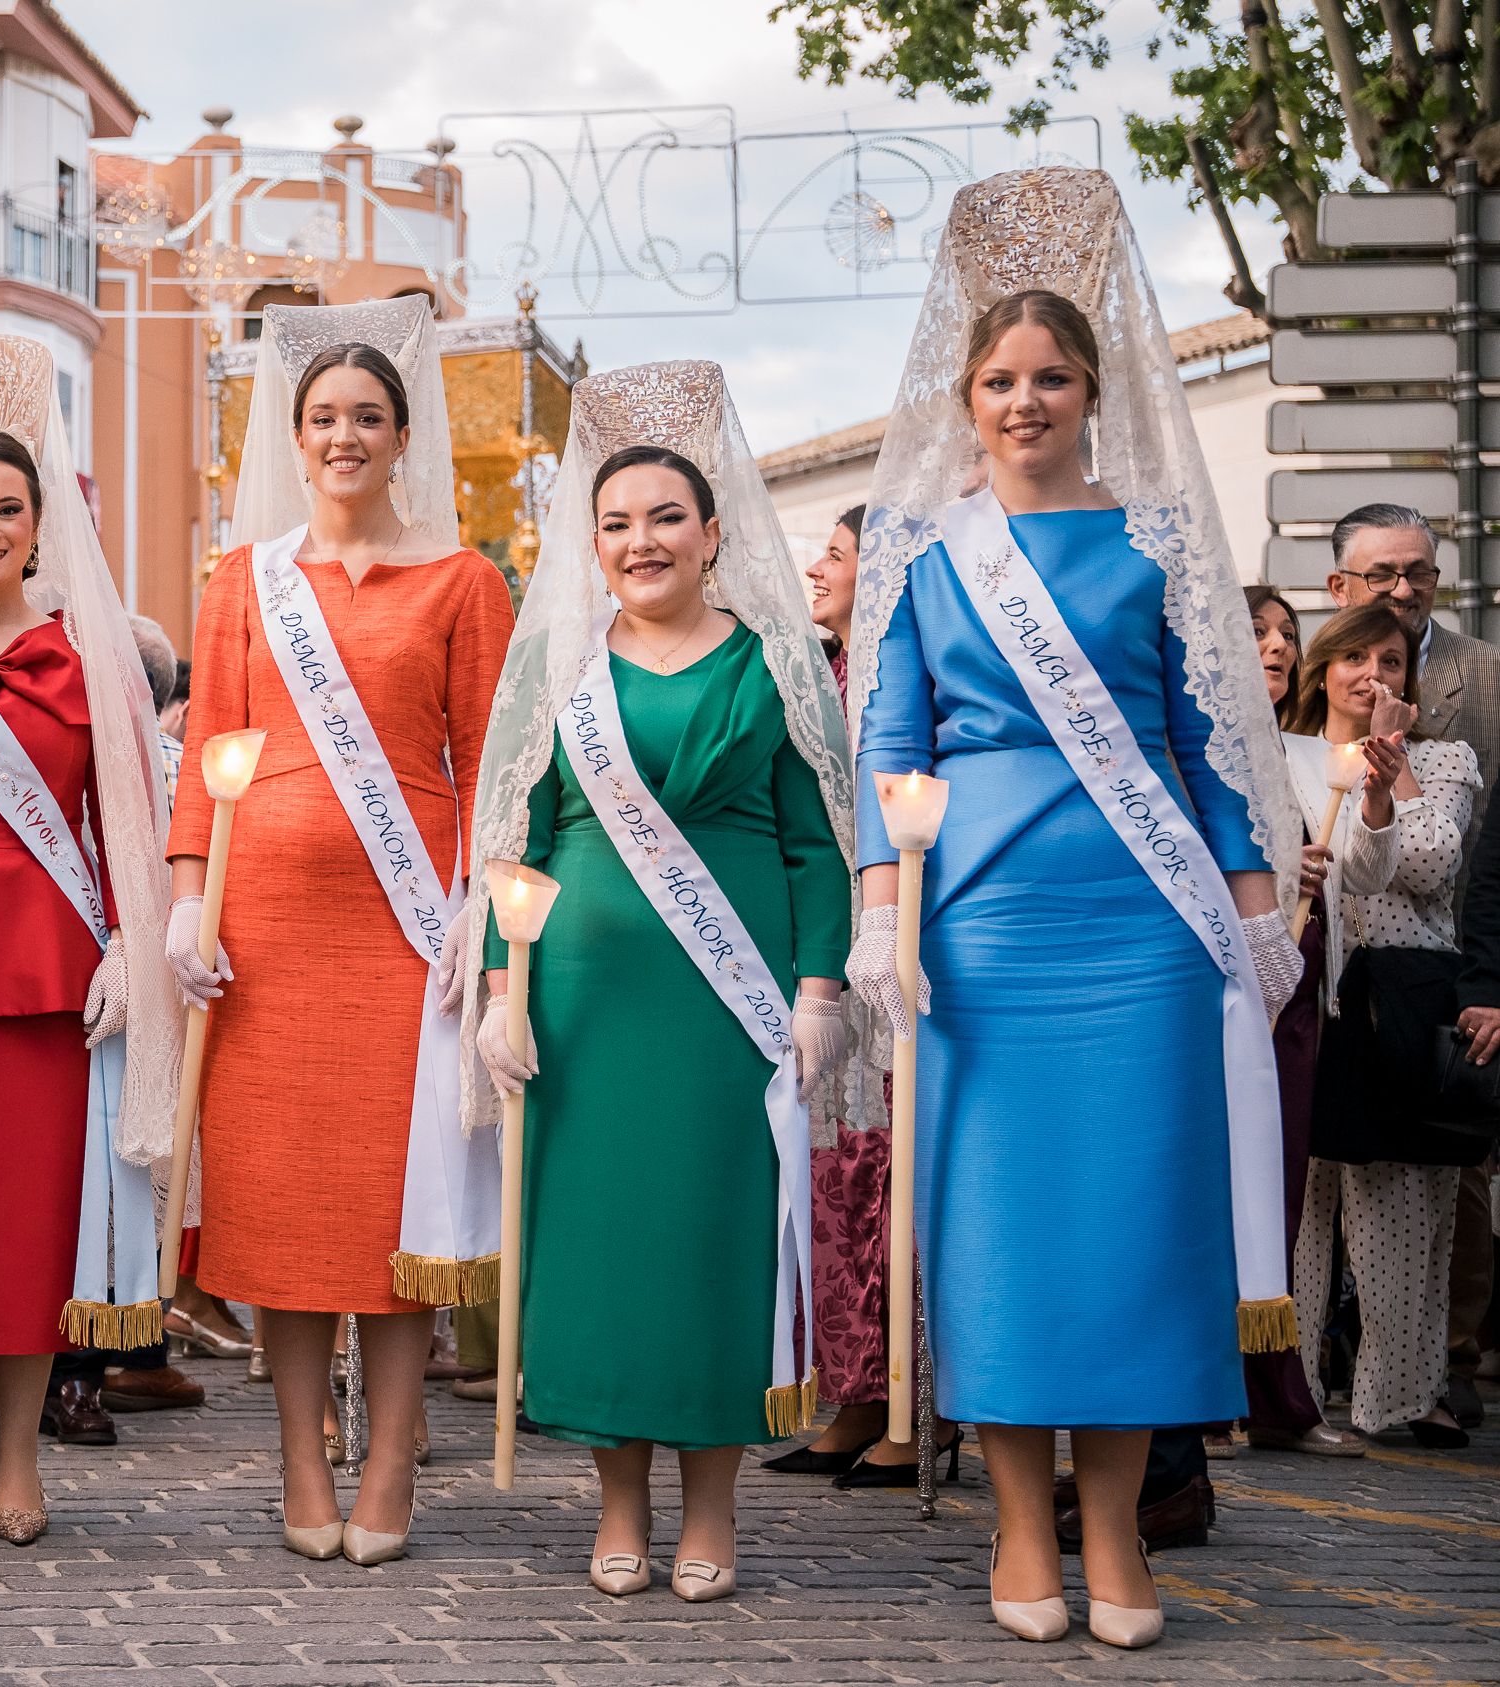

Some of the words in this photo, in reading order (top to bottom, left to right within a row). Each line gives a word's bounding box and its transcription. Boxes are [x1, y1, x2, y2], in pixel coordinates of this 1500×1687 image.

[15, 787, 59, 856] MAYOR
[280, 611, 329, 693] DAMA
[323, 714, 359, 756] DE
[355, 778, 412, 882] HONOR
[570, 692, 613, 777] DAMA
[617, 803, 658, 846] DE
[659, 866, 734, 971] HONOR
[744, 989, 789, 1044] 2026
[999, 596, 1072, 689] DAMA
[1068, 711, 1112, 757] DE
[1110, 778, 1192, 886] HONOR
[1201, 907, 1237, 965] 2026
